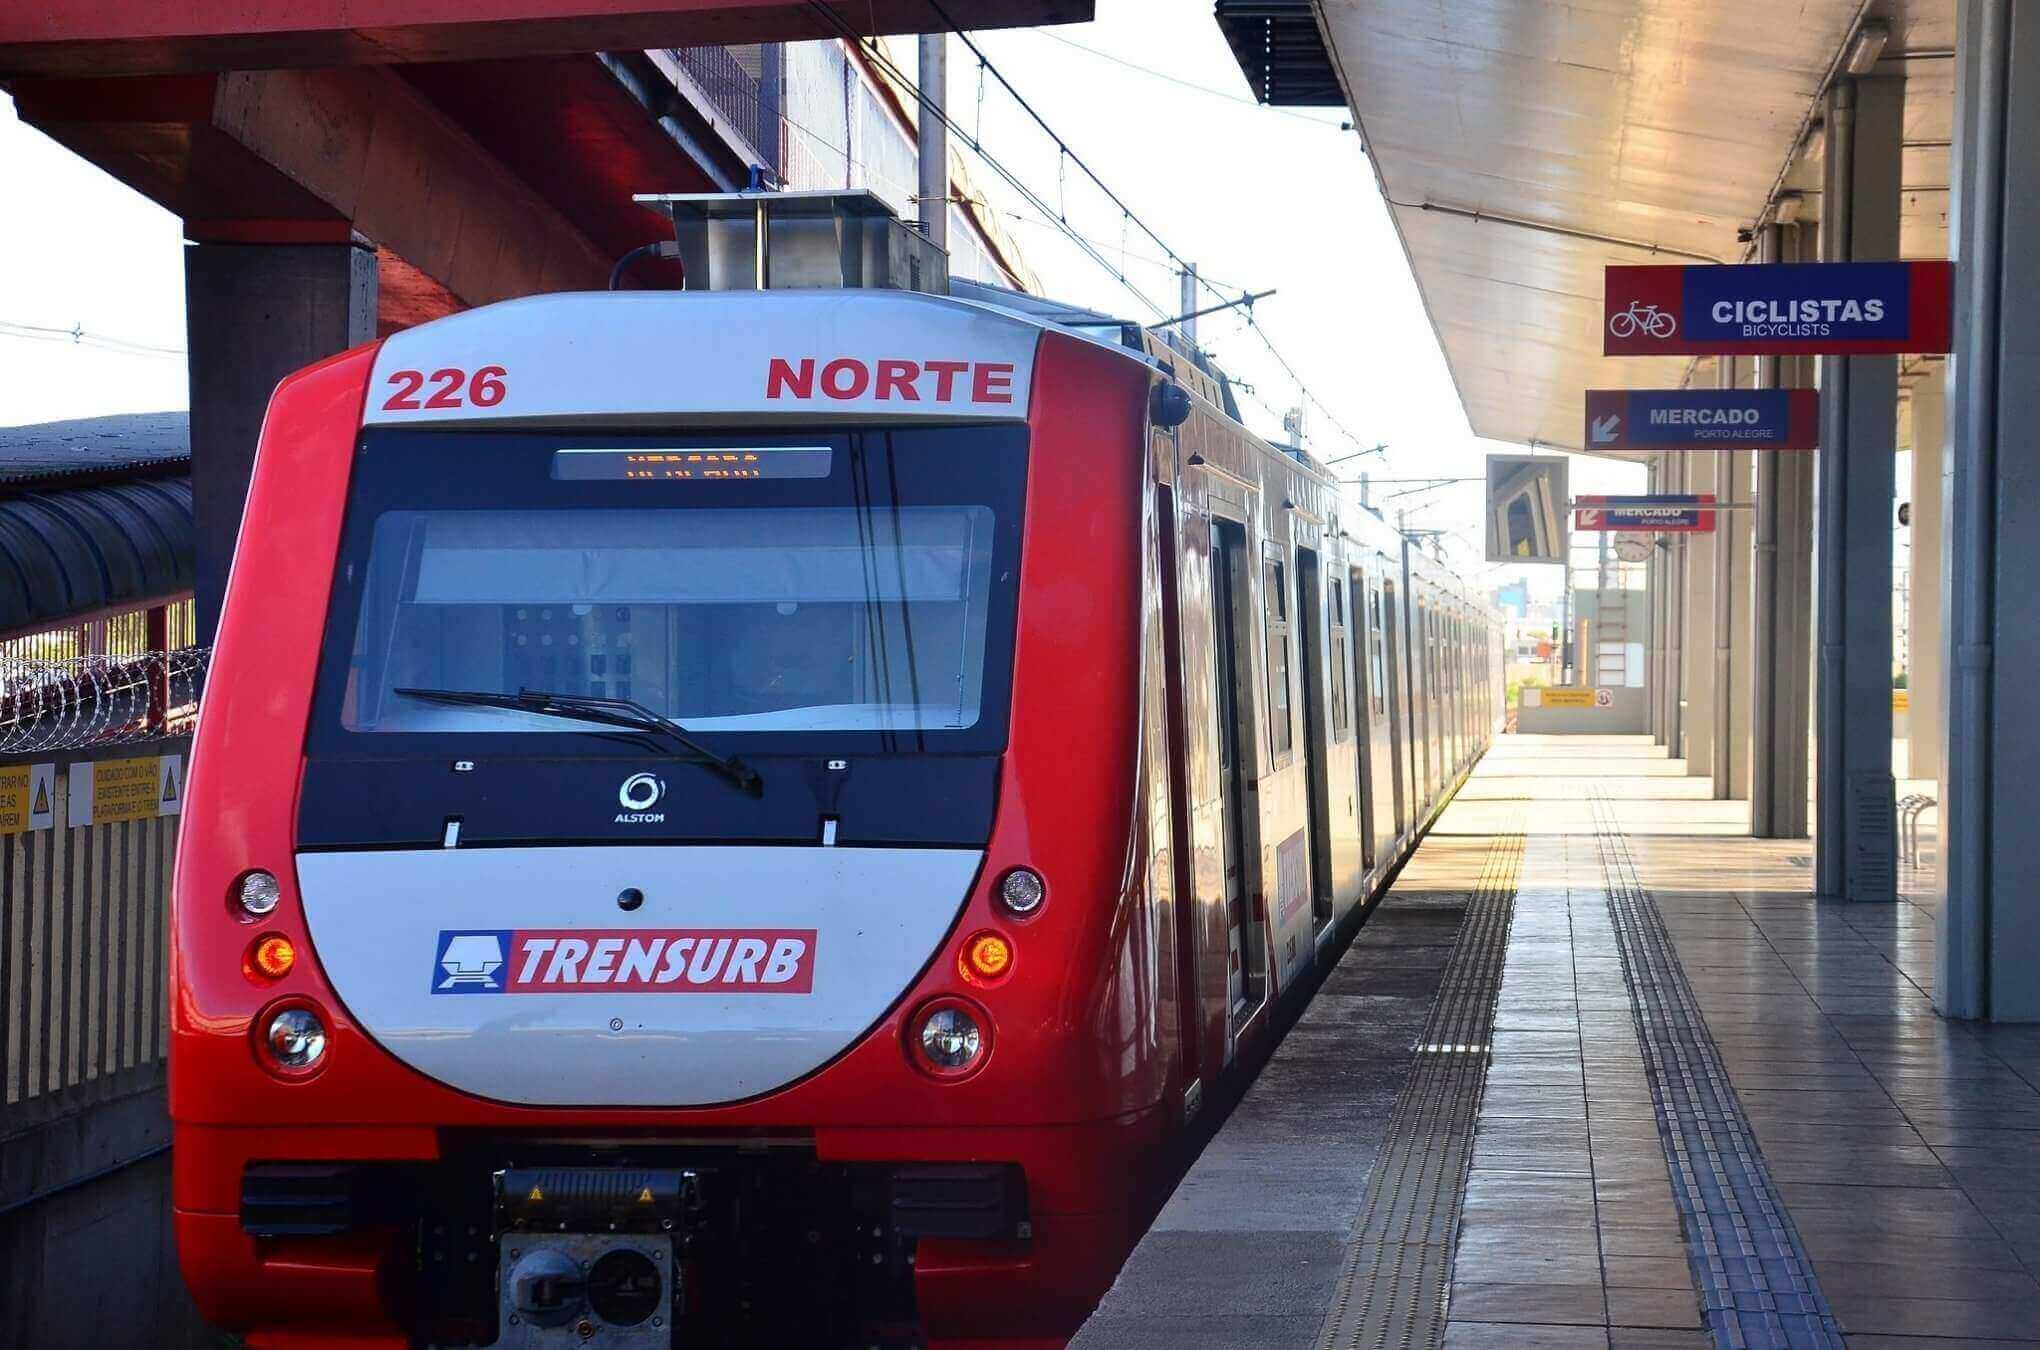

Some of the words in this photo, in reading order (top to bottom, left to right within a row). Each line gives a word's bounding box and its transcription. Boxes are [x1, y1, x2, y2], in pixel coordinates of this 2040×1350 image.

[1711, 299, 1885, 323] CICLISTAS
[1742, 323, 1831, 336] BICYCLISTS
[381, 366, 508, 411] 226
[765, 358, 1015, 404] NORTE
[1649, 408, 1760, 425] MERCADO
[1694, 429, 1730, 439] PORTO
[1732, 428, 1774, 439] ALEGRE
[614, 813, 665, 824] ALSTOM
[517, 937, 806, 985] TRENSURB
